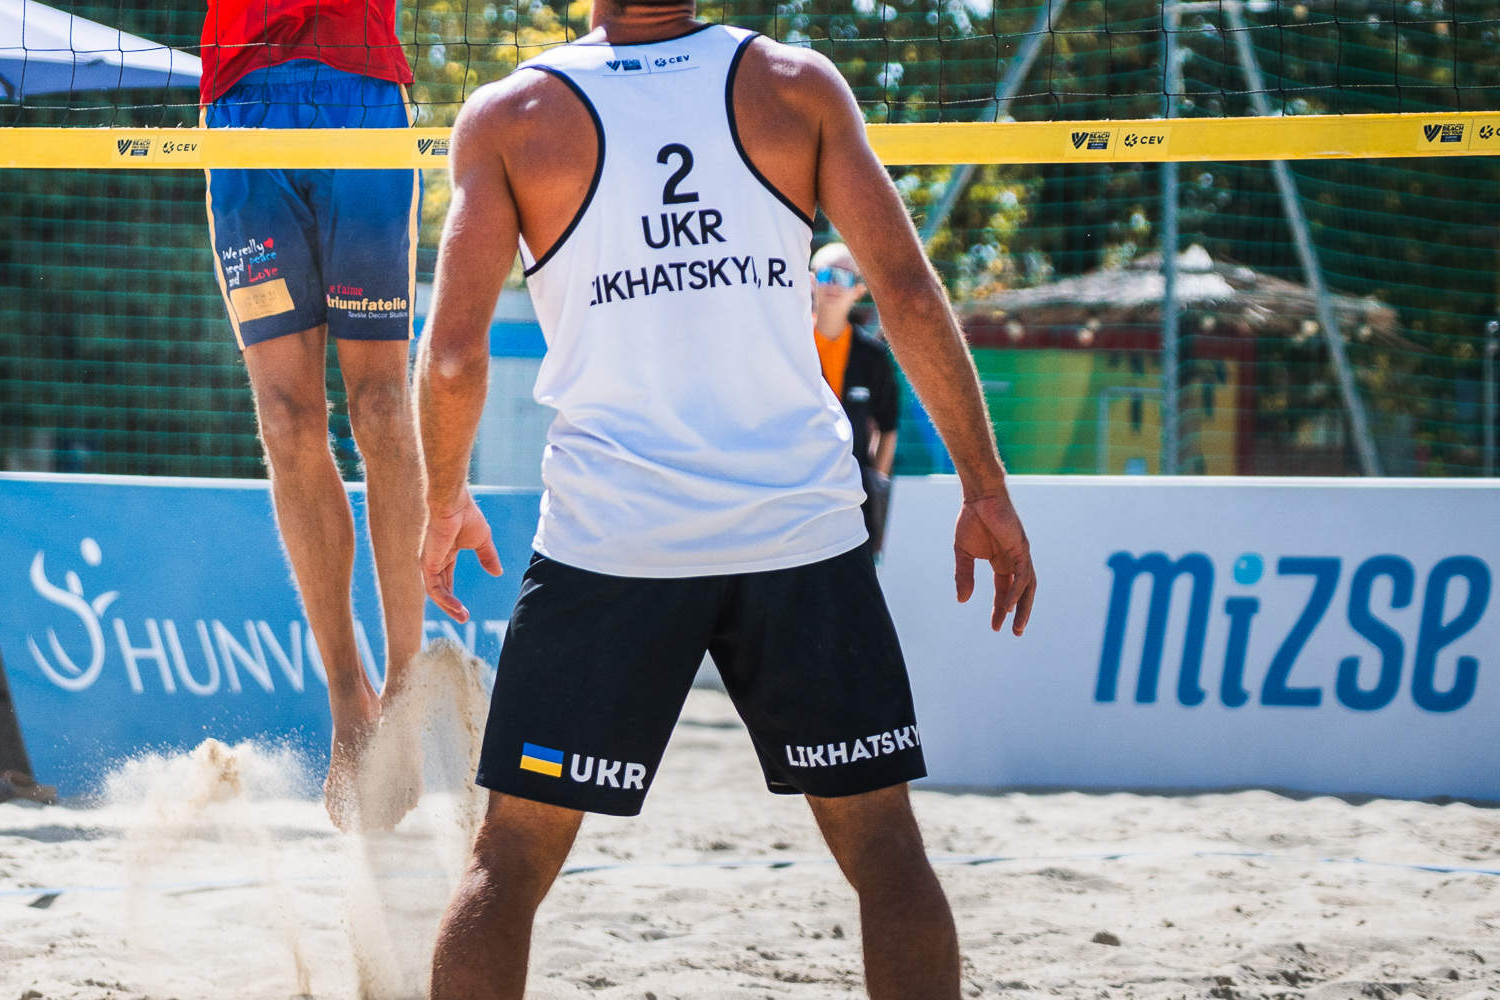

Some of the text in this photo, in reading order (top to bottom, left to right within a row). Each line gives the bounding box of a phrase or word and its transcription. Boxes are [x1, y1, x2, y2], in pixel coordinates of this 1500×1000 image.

[669, 55, 689, 64] CEV
[1140, 136, 1164, 144] CEV
[656, 143, 700, 205] 2
[641, 208, 727, 249] UKR
[222, 238, 265, 260] We really
[249, 251, 277, 269] peace
[248, 264, 278, 282] Love
[768, 257, 793, 288] R.
[368, 311, 388, 319] Decor
[785, 725, 920, 768] LIKHATSKY
[570, 753, 647, 790] UKR
